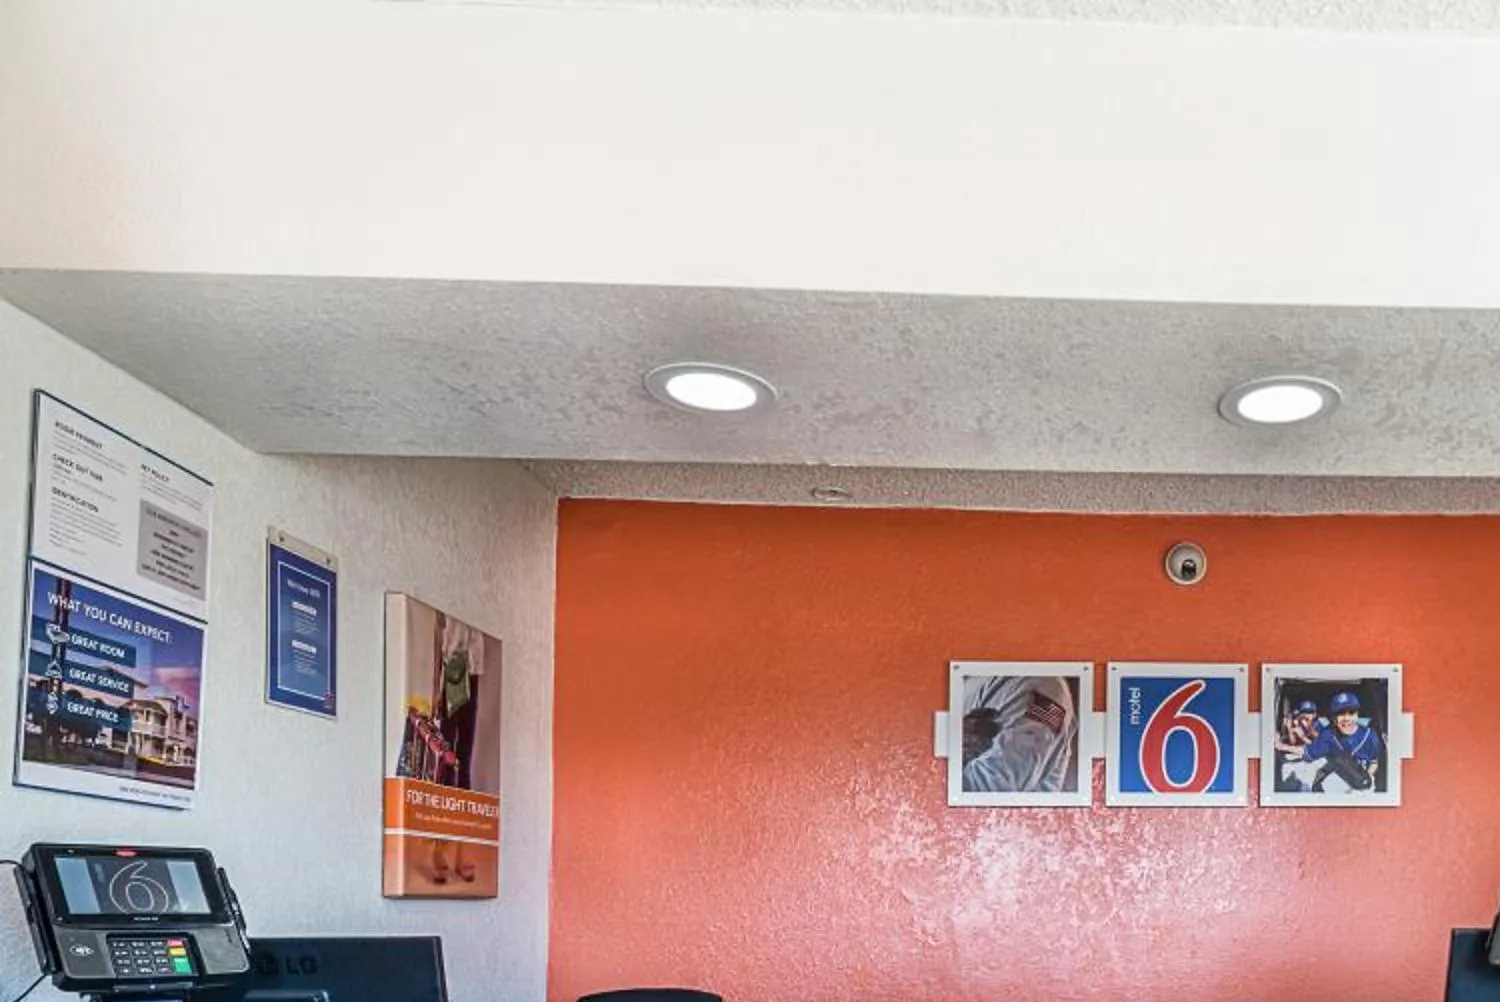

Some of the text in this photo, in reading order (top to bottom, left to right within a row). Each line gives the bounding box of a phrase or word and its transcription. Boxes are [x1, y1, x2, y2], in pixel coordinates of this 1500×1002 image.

[47, 591, 81, 612] WHAT
[84, 603, 107, 621] YOU
[109, 613, 133, 631] CAN
[71, 633, 125, 659] GREAT ROOM
[69, 667, 129, 693] GREAT SERVICE
[67, 702, 119, 723] GREAT PRICE
[1128, 679, 1220, 795] motel 6
[406, 789, 423, 806] FOR
[423, 792, 440, 809] THE
[441, 797, 466, 813] LIGHT
[109, 861, 168, 914] 6
